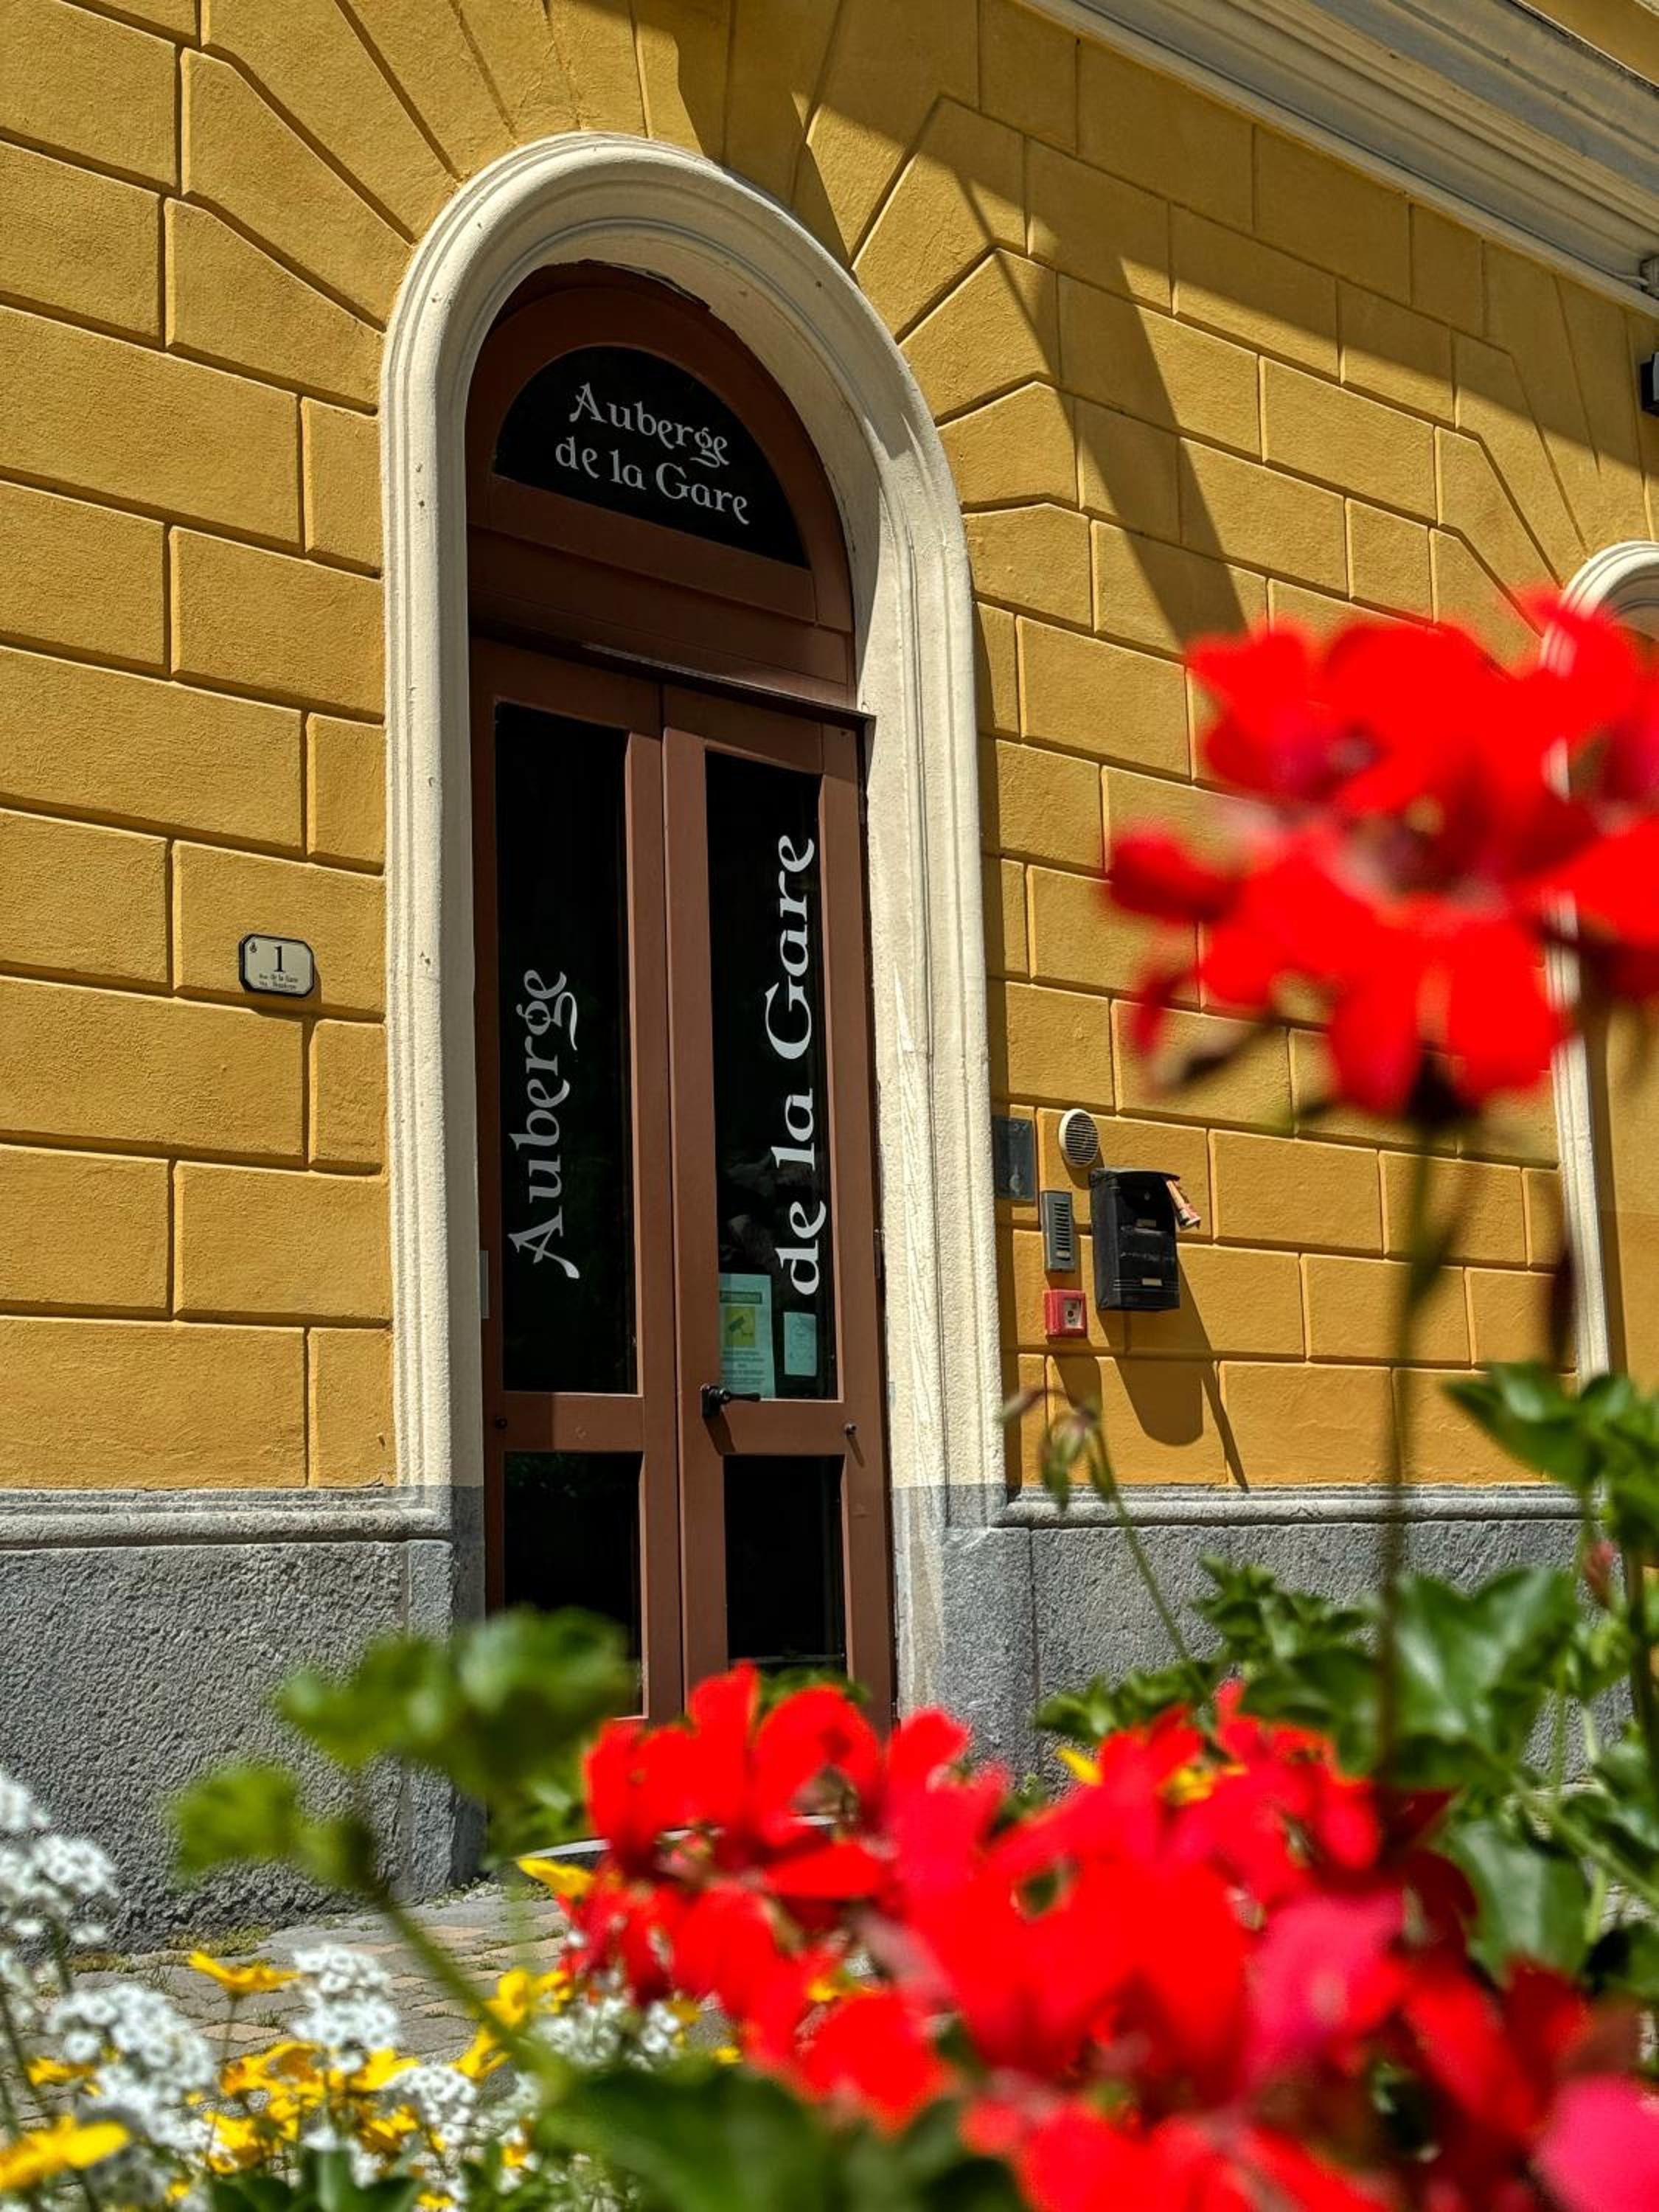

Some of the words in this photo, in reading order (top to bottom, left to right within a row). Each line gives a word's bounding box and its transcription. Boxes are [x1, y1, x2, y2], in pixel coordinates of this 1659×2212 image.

[568, 382, 730, 467] Auberge
[554, 436, 599, 479] de
[609, 449, 647, 490] la
[655, 462, 750, 525] Gare
[274, 946, 285, 973] 1
[765, 835, 815, 1060] Gare
[508, 969, 580, 1280] Auberge
[771, 1088, 815, 1171] la
[775, 1200, 827, 1295] de
